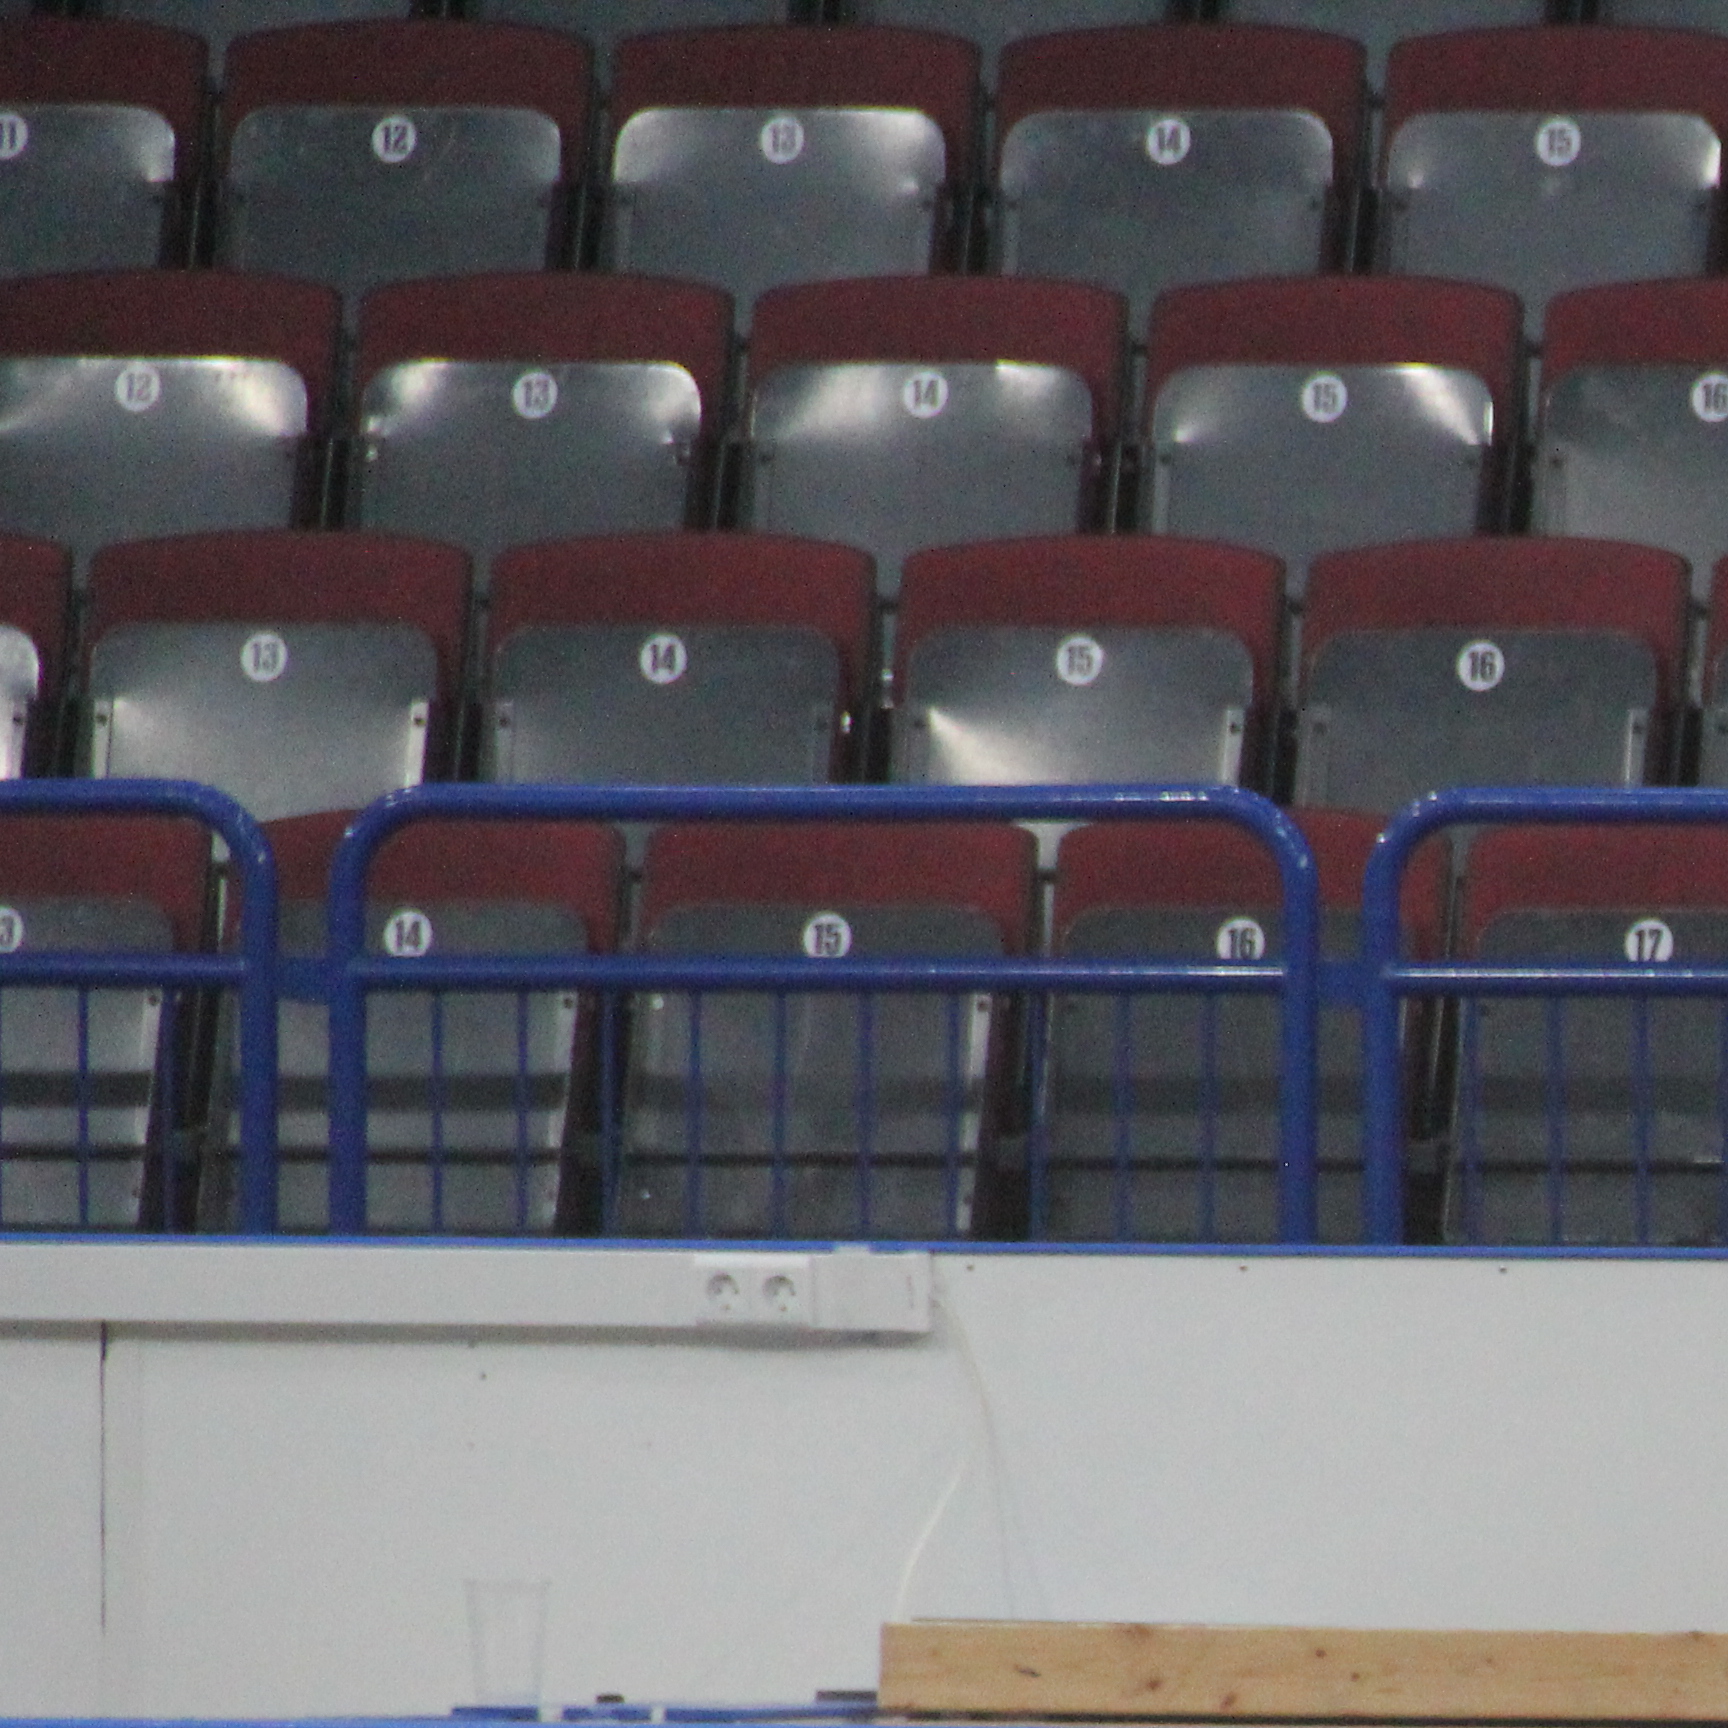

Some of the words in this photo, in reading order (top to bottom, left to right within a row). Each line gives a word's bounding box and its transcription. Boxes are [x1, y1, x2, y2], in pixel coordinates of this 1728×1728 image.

[383, 124, 408, 154] 12
[1156, 127, 1181, 154] 14
[1547, 128, 1572, 157] 15
[126, 373, 152, 404] 12
[524, 379, 550, 410] 13
[913, 379, 938, 406] 14
[1313, 383, 1338, 413] 15
[1703, 383, 1728, 413] 16
[253, 642, 279, 672] 13
[650, 643, 676, 673] 14
[1066, 644, 1093, 674] 15
[1469, 651, 1496, 681] 16
[396, 920, 422, 951] 14
[814, 923, 841, 955] 15
[1229, 928, 1255, 961] 16
[1635, 928, 1662, 961] 17
